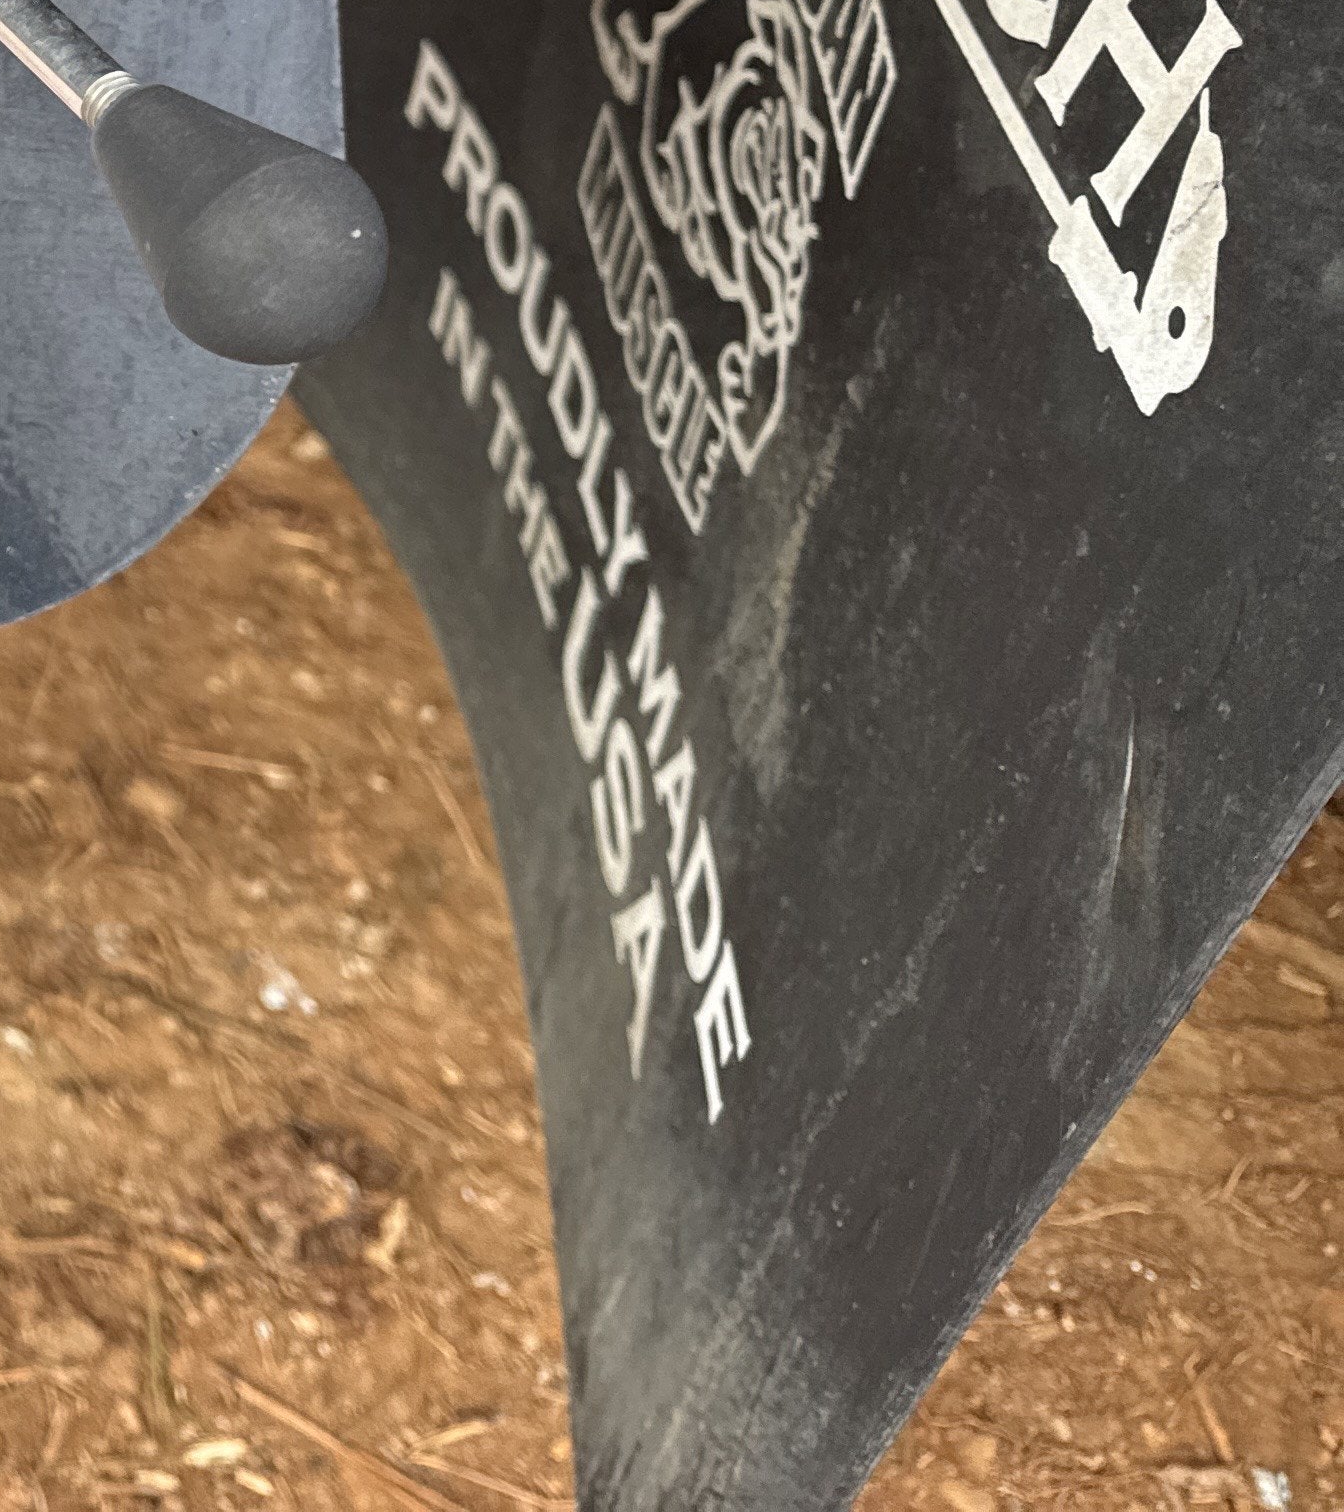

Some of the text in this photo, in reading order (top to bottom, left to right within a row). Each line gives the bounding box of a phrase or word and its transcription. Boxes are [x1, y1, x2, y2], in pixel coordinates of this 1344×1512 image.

[403, 39, 752, 1125] PROUDLY MADE
[428, 266, 668, 1081] IN THE USA
